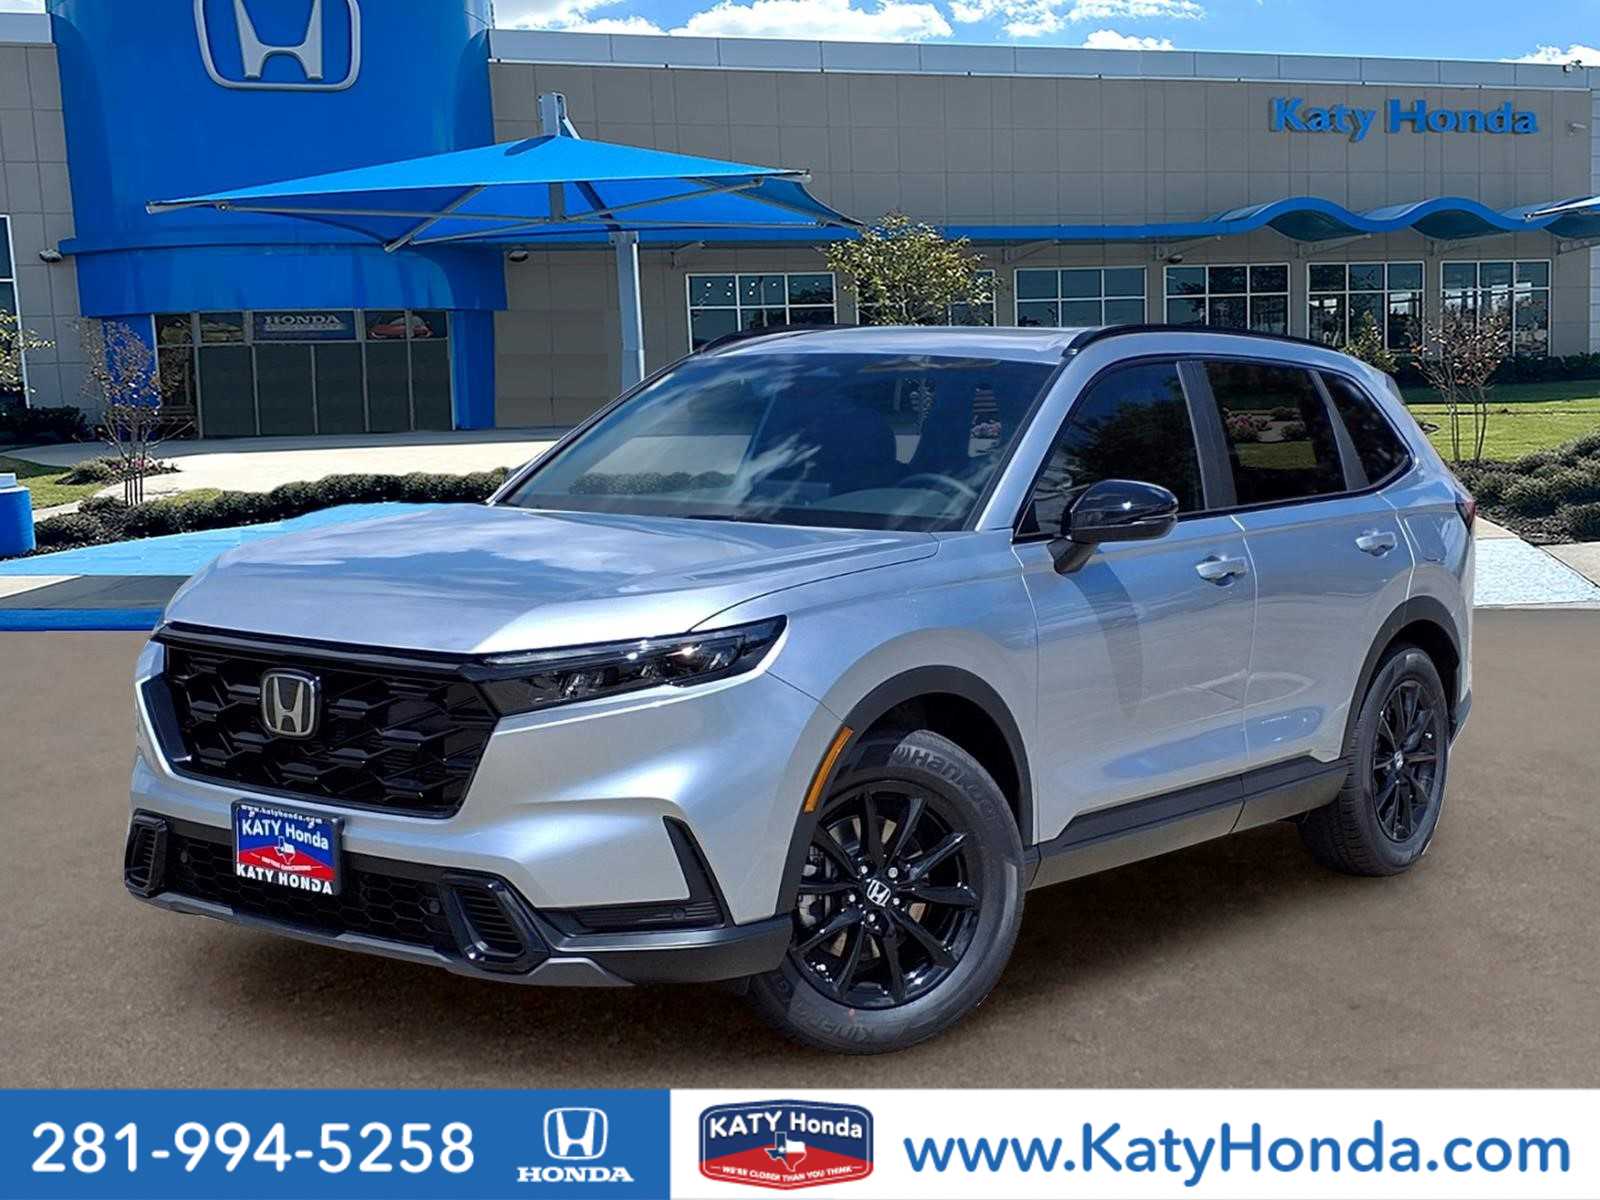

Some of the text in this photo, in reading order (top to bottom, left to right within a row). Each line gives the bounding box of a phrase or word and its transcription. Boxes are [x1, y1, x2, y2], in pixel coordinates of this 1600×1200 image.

[1269, 97, 1539, 143] Katy Honda
[264, 315, 341, 325] HONDA
[242, 818, 330, 851] KATY Honda
[236, 863, 274, 883] KATY
[278, 872, 334, 895] HONDA
